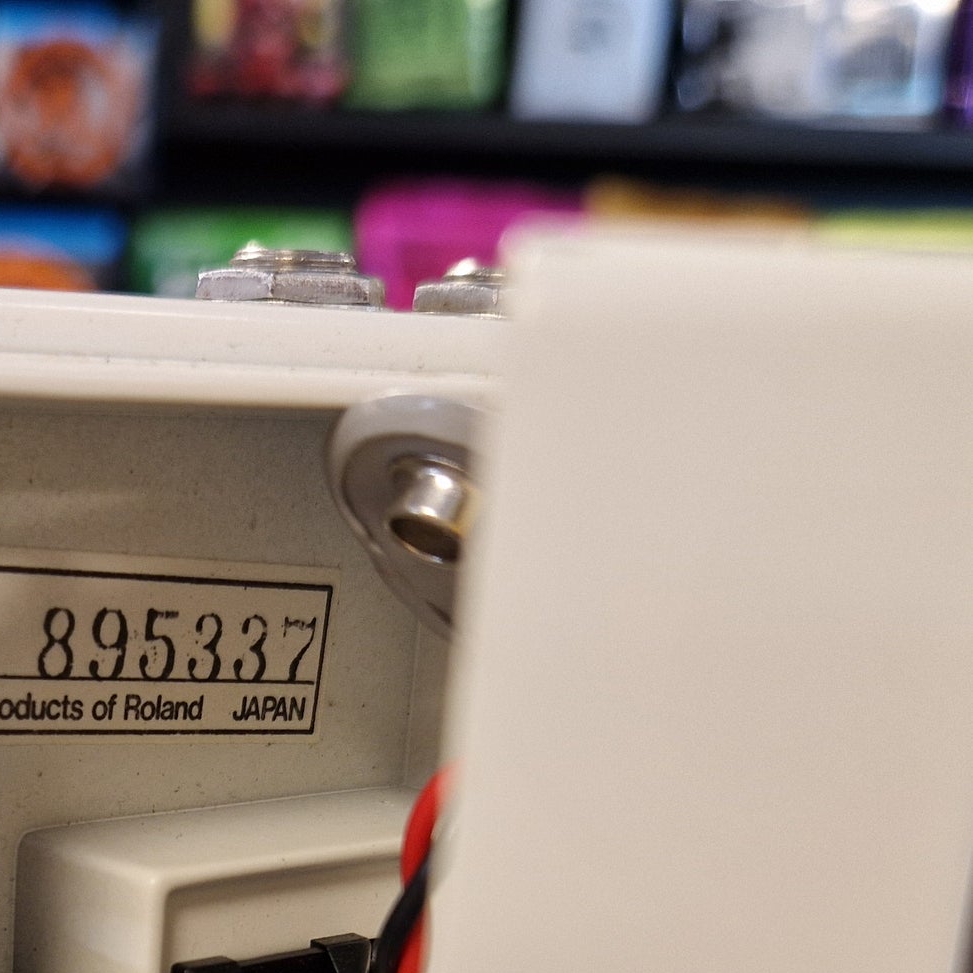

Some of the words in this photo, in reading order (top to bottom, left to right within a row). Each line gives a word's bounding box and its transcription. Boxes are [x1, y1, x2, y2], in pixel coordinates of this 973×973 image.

[37, 606, 317, 682] 895337
[91, 693, 118, 721] of
[124, 694, 204, 722] Roland
[232, 695, 306, 722] JAPAN
